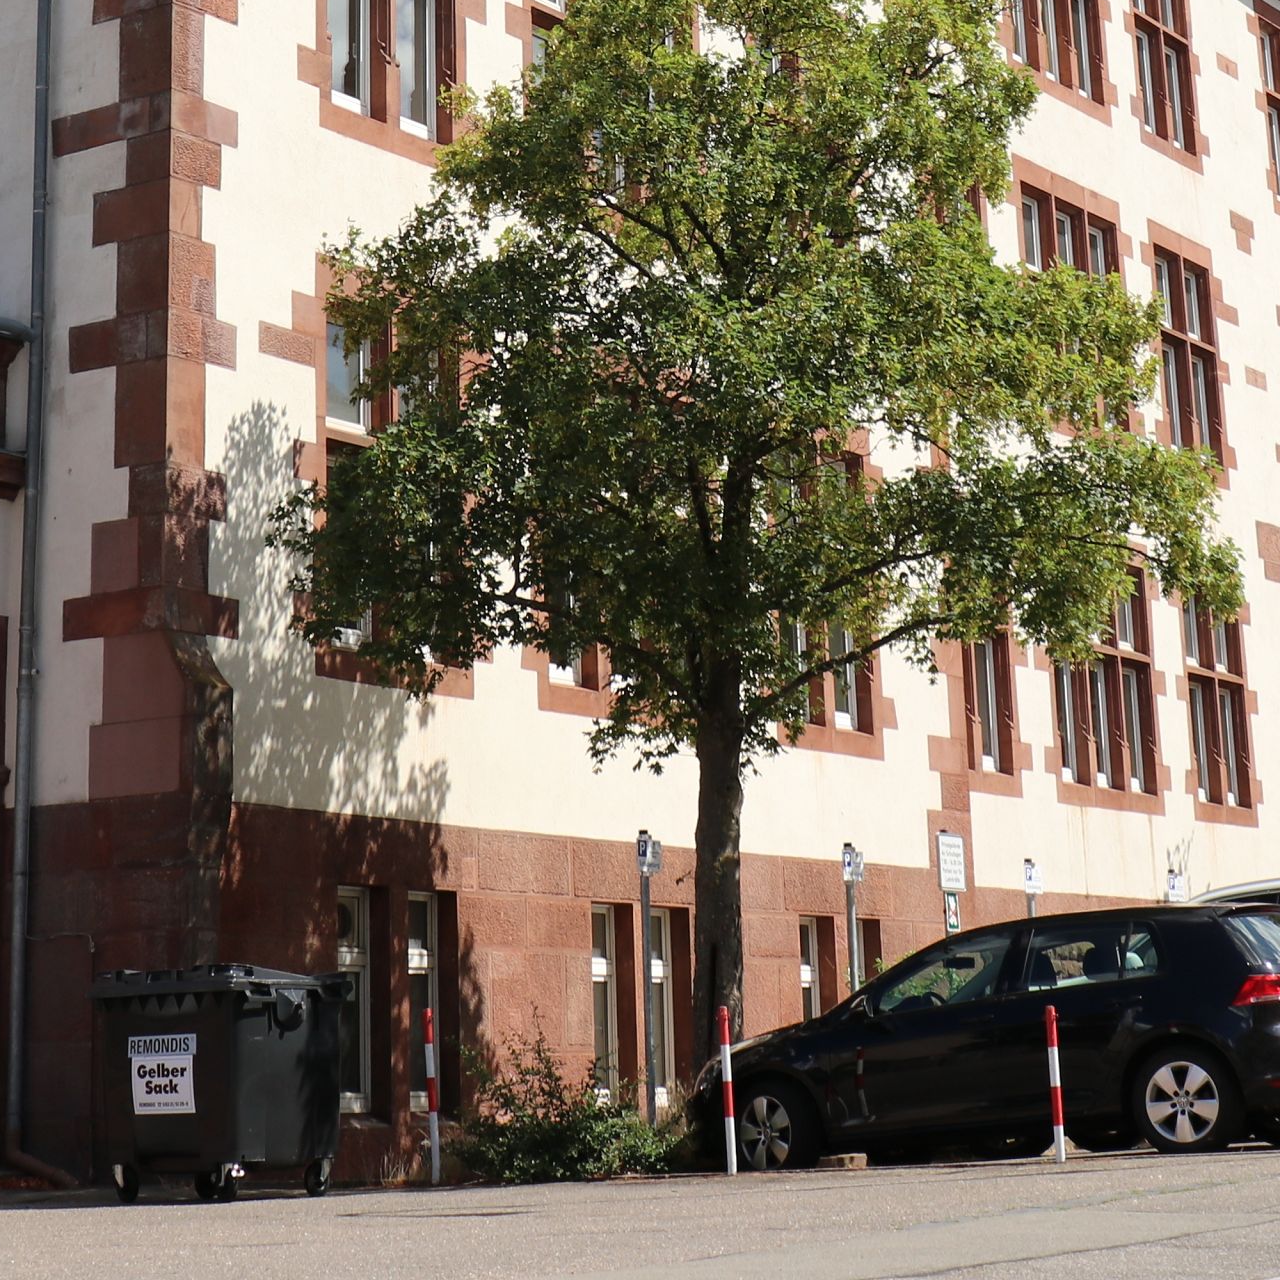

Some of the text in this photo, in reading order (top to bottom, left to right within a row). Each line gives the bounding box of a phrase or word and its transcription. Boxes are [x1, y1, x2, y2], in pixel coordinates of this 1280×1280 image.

[639, 841, 646, 855] P
[844, 852, 851, 867] P
[129, 1036, 190, 1055] REMONDIS
[136, 1062, 187, 1079] Gelber
[145, 1079, 179, 1095] Sack
